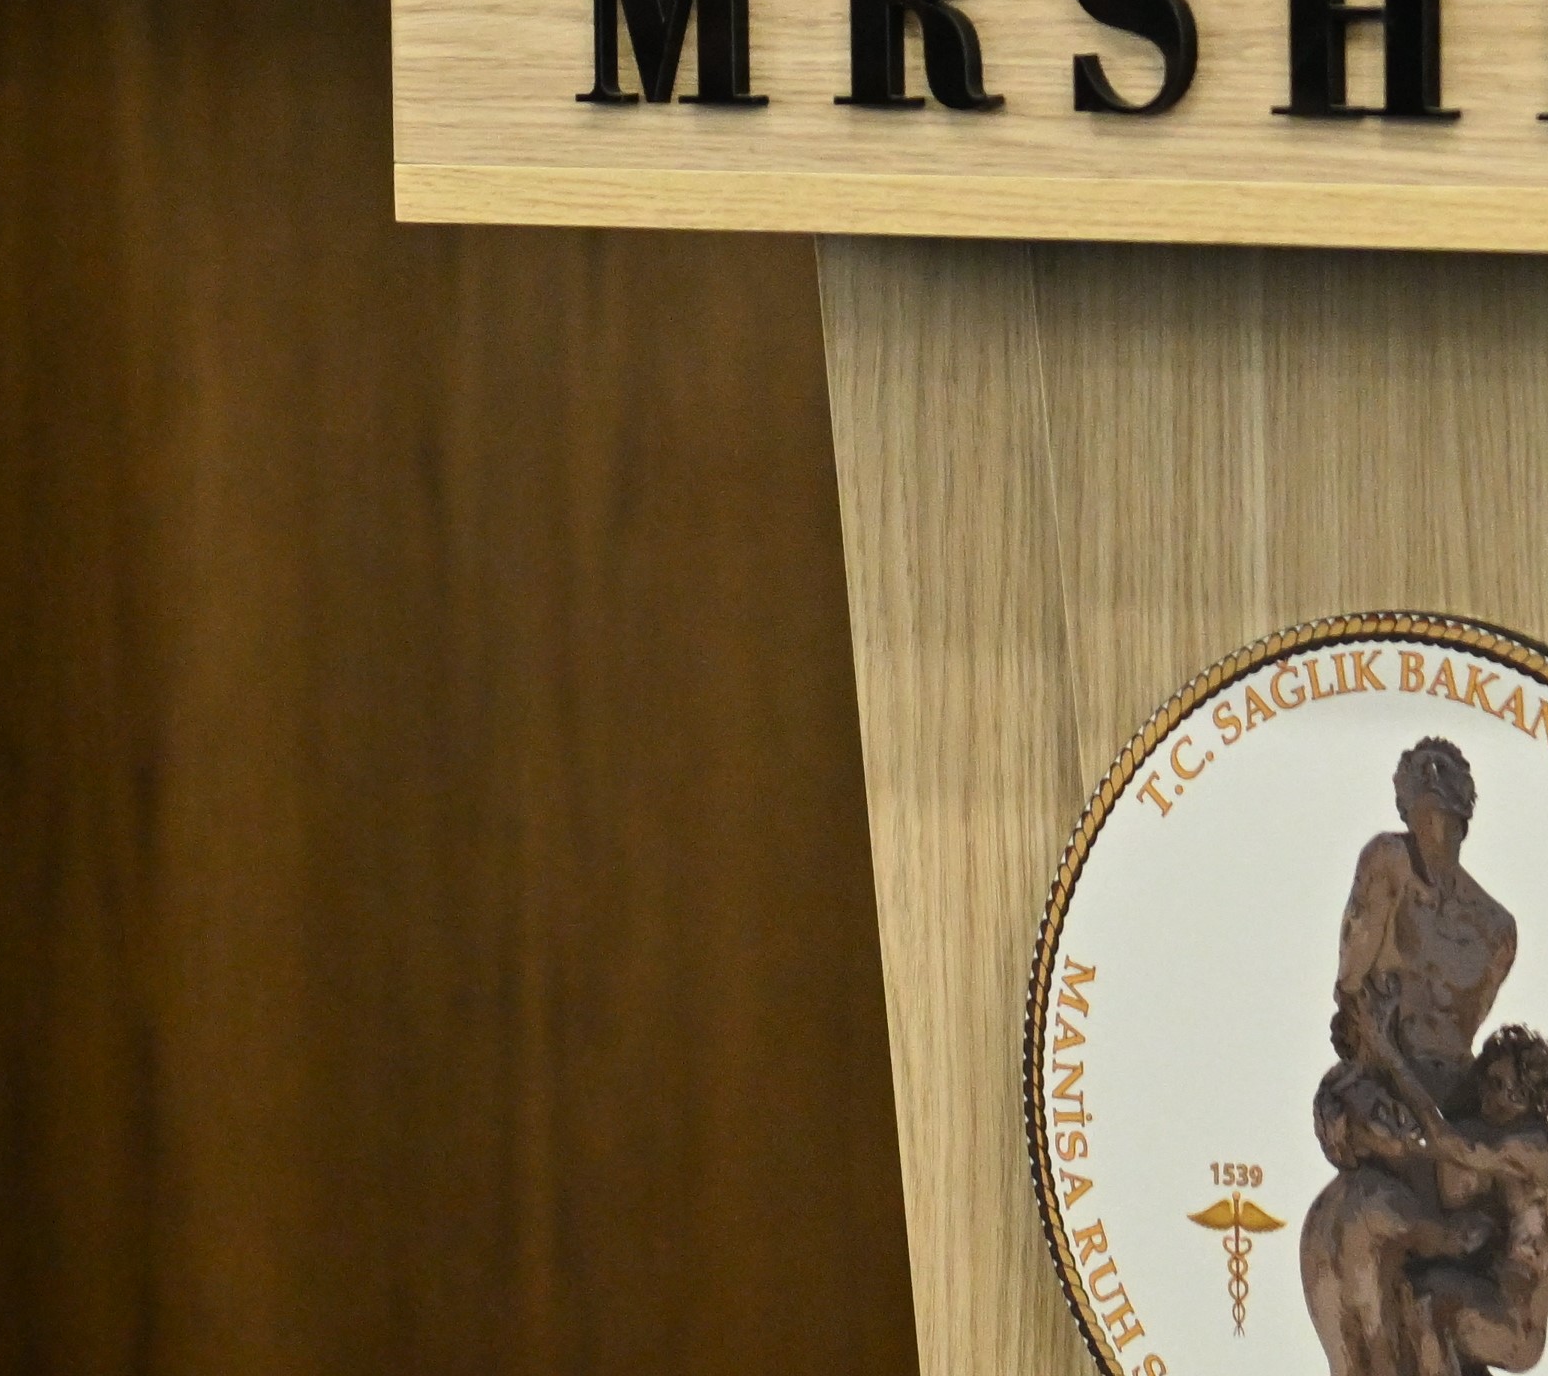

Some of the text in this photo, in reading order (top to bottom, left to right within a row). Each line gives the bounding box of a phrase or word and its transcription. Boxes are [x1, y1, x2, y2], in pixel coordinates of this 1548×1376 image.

[1135, 733, 1216, 819] T.C.
[1211, 648, 1387, 747] SAĞLIK
[1051, 953, 1146, 1354] MANİSA RUH
[1209, 1161, 1264, 1189] 1539
